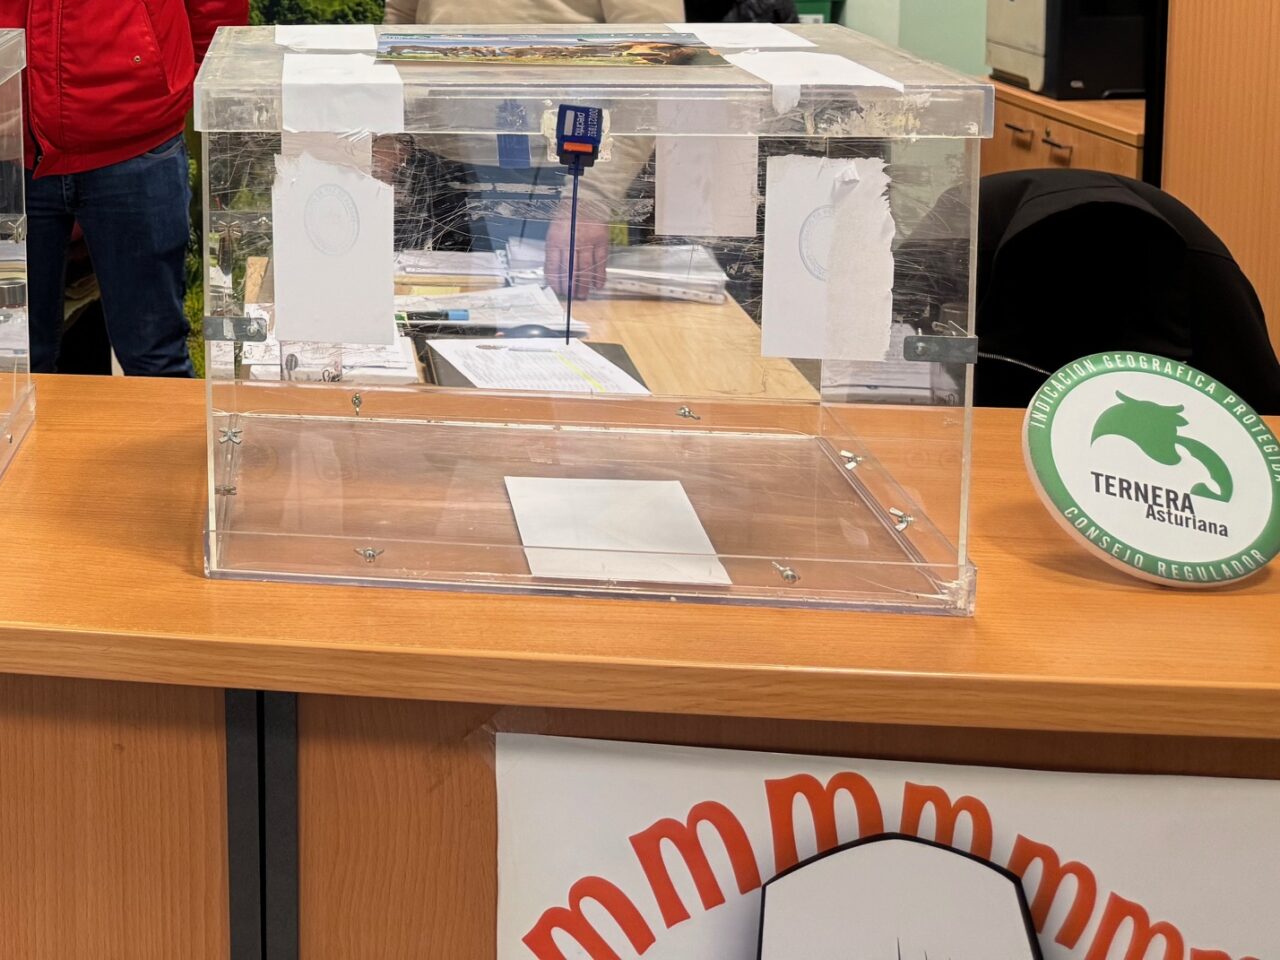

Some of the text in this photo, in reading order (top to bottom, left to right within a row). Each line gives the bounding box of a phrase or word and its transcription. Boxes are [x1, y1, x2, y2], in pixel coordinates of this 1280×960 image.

[1029, 358, 1098, 429] INDICACION
[1101, 353, 1218, 395] GEOGRAFICA
[1090, 470, 1196, 515] TERNERA
[1145, 504, 1229, 538] Asturiana
[1063, 506, 1267, 582] CONSEJO REGULADOR
